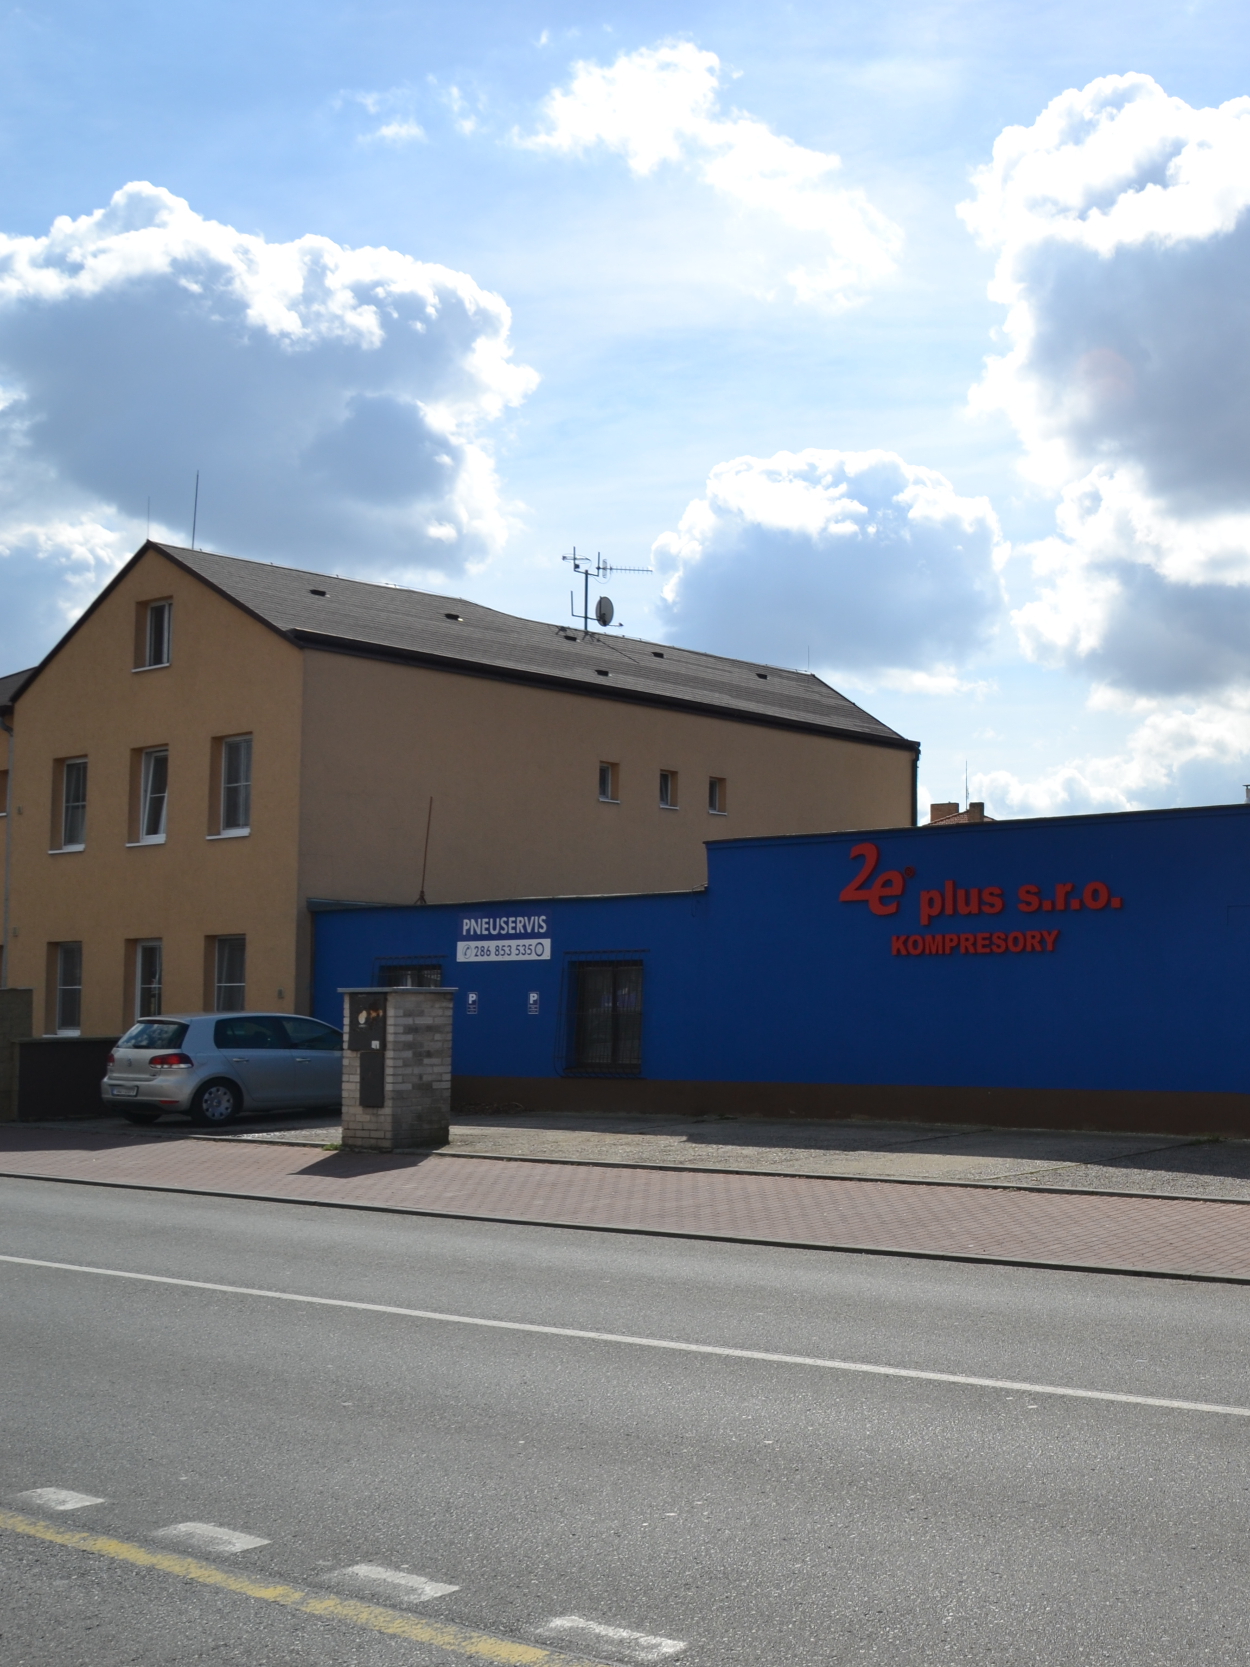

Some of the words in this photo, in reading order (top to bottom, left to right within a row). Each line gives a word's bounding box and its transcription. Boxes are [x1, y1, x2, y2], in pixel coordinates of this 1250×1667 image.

[838, 842, 904, 916] 2e
[919, 880, 1004, 926] plus
[1017, 879, 1122, 913] s.r.o.
[462, 915, 547, 936] PNEUSERVIS
[474, 945, 491, 957] 286
[494, 945, 512, 957] 853
[515, 944, 533, 956] 535
[891, 930, 1059, 956] KOMPRESORY
[468, 993, 477, 1004] P
[529, 993, 538, 1004] P
